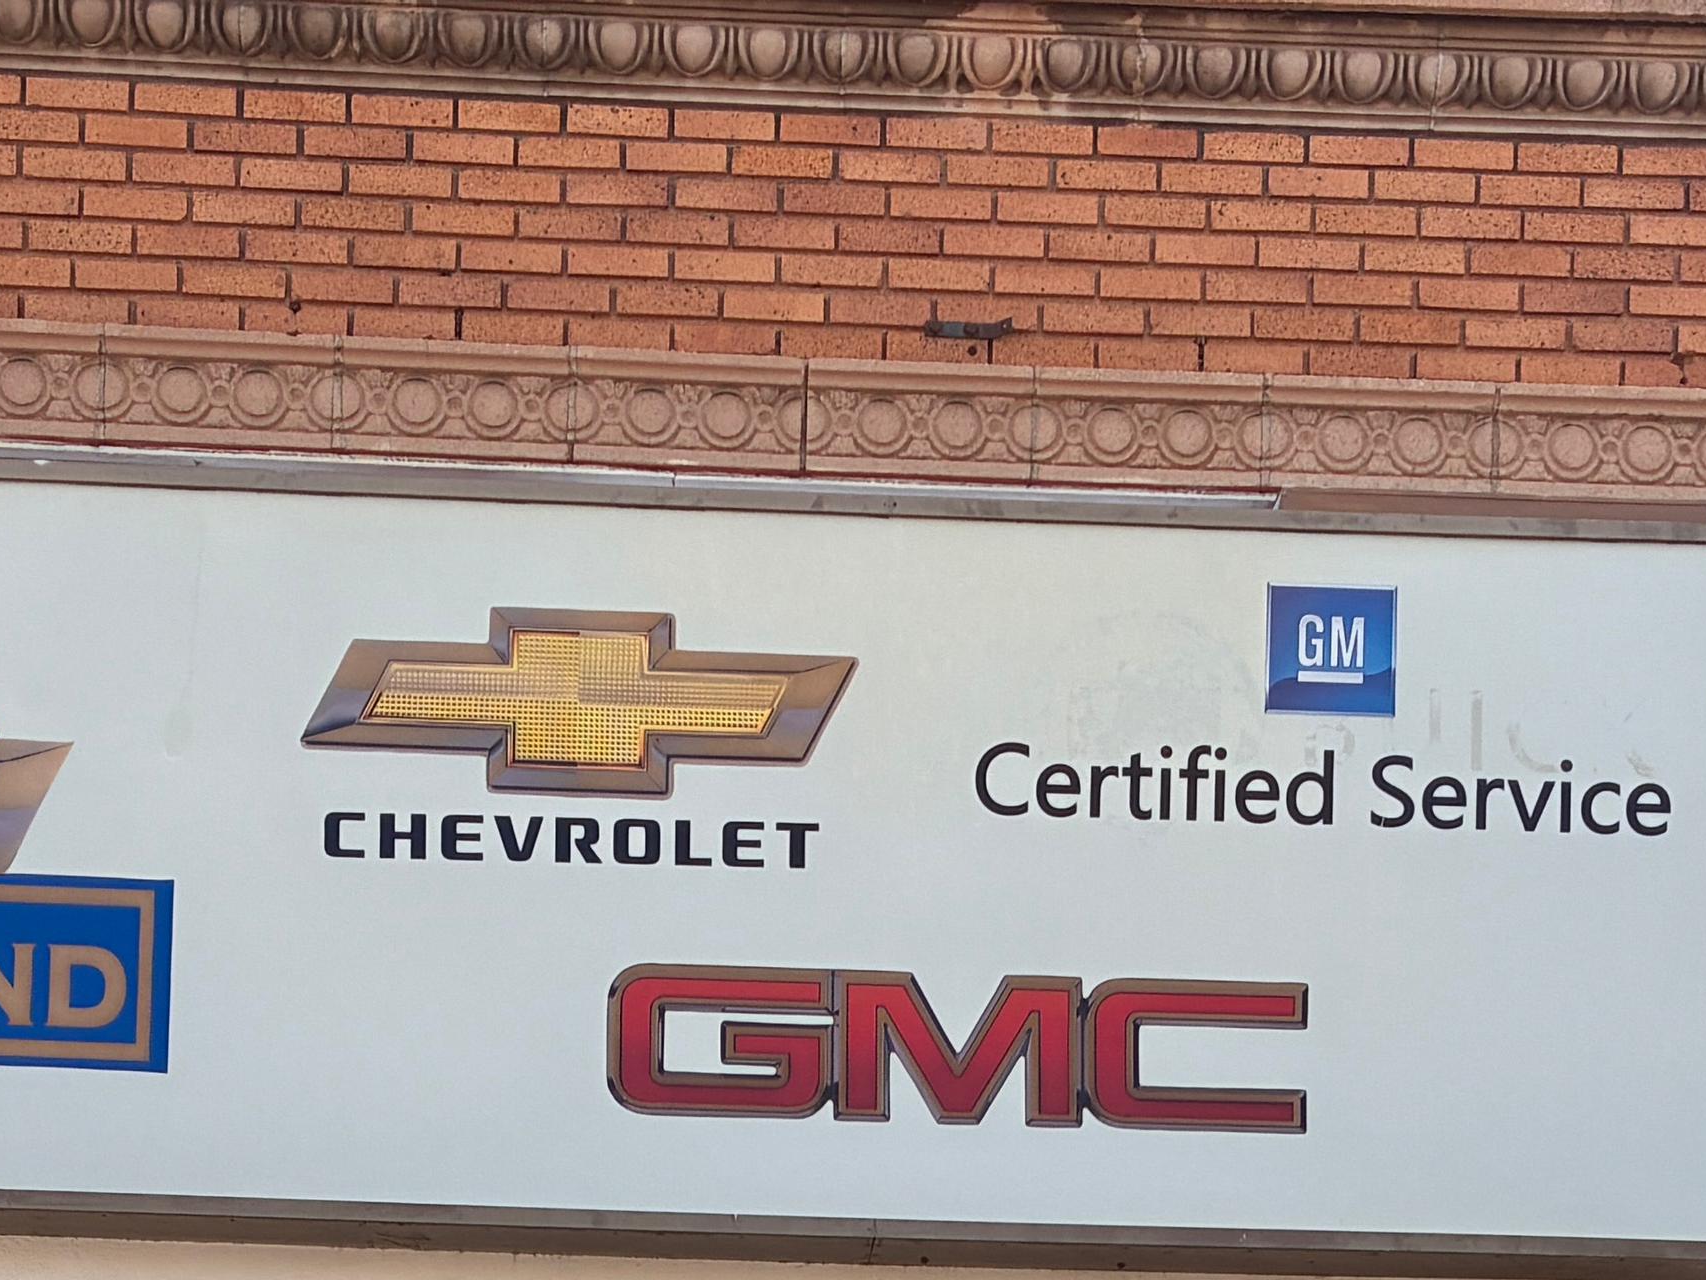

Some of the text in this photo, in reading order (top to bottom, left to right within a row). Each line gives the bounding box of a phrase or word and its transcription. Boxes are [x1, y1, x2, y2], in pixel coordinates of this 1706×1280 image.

[1297, 614, 1365, 668] GM
[975, 743, 1673, 838] Certified Service
[323, 811, 820, 871] CHEVROLET
[607, 962, 1310, 1134] GMC
